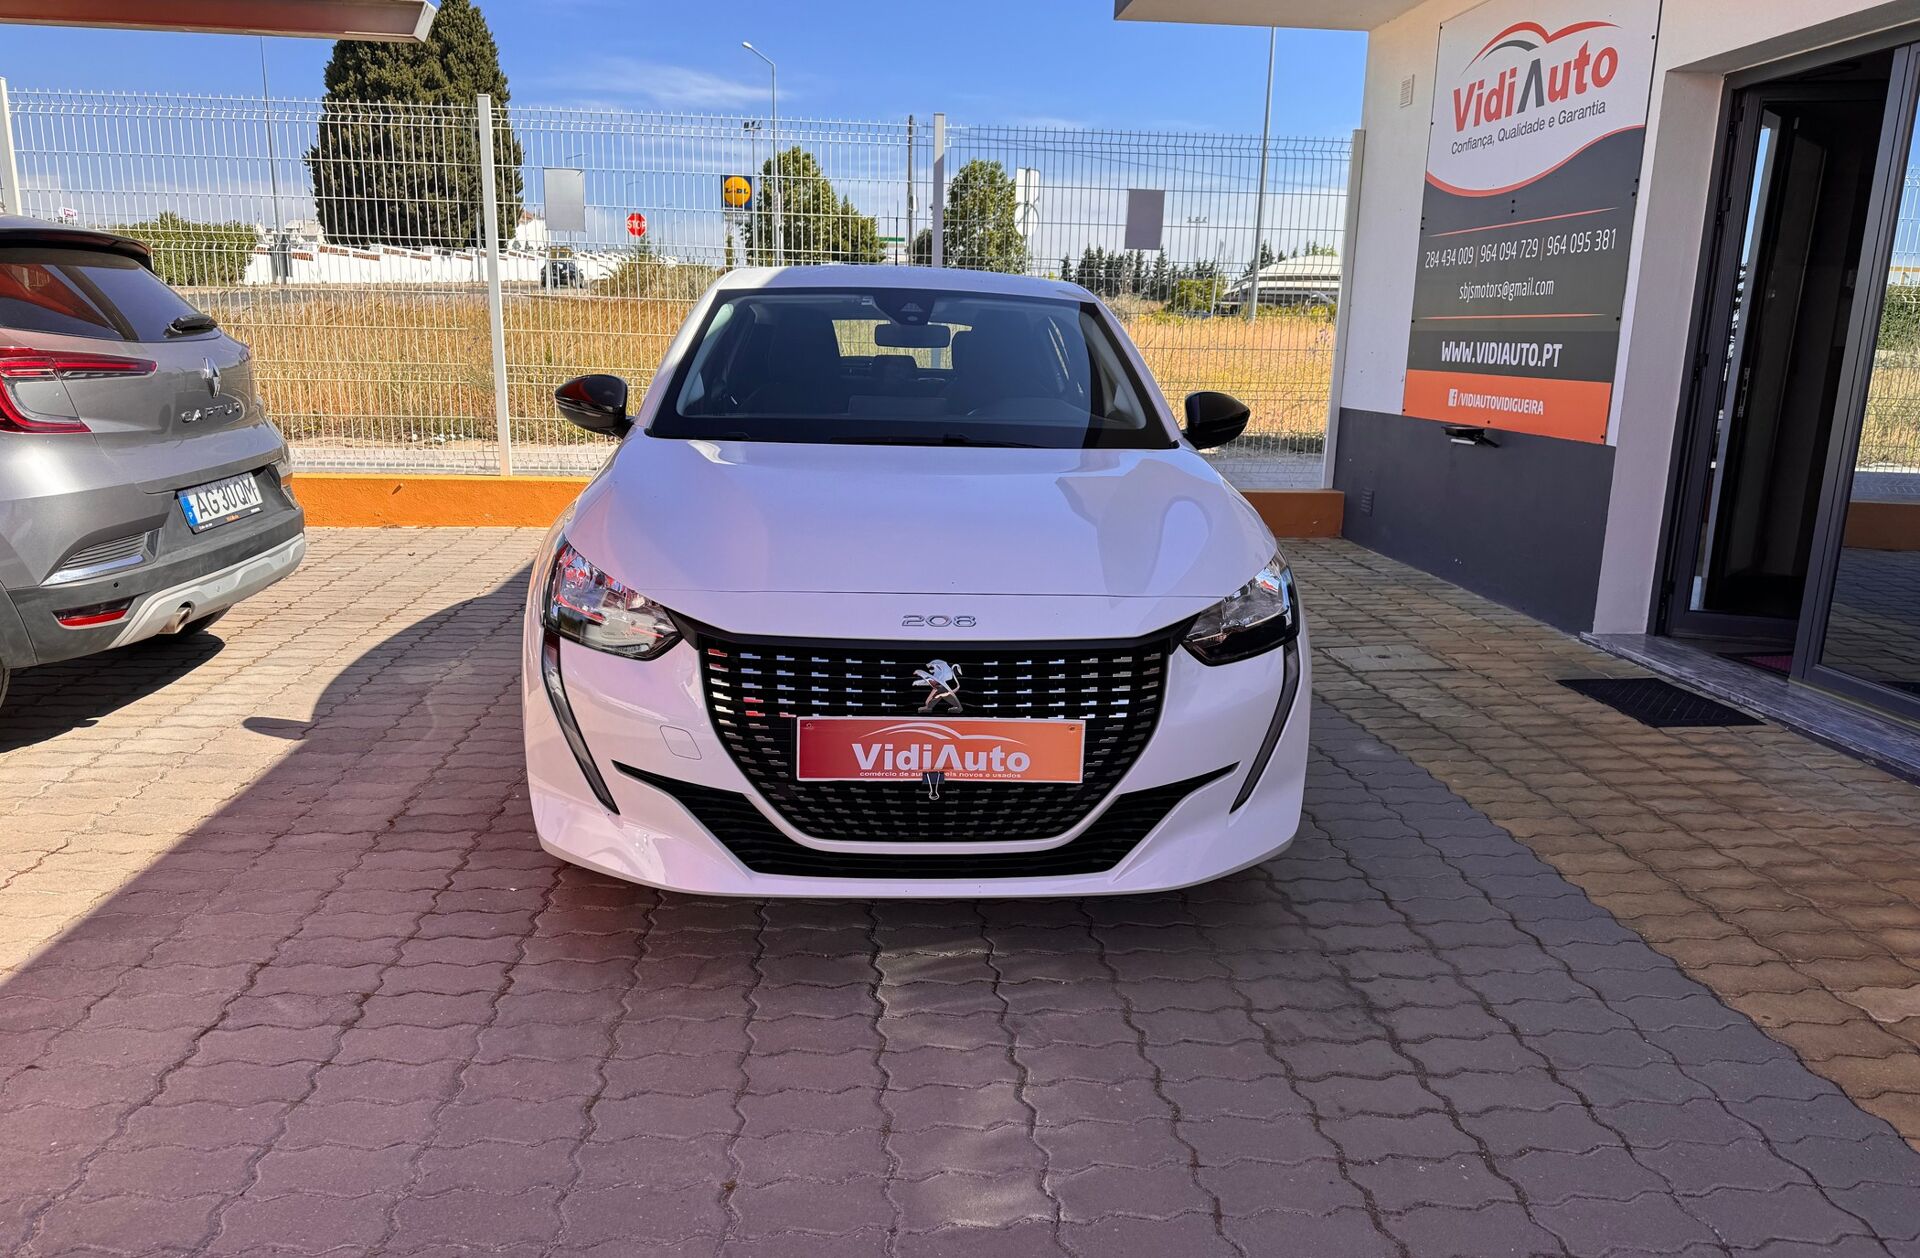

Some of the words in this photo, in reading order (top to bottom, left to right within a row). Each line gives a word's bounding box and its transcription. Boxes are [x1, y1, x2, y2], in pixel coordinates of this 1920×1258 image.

[1453, 40, 1619, 132] VidiAuto
[1451, 130, 1495, 155] Confiança,
[1497, 117, 1546, 142] Qualidade
[1548, 116, 1555, 128] e
[1558, 99, 1606, 125] Garantia
[627, 220, 647, 229] STOP
[1425, 250, 1440, 268] 284
[1441, 248, 1456, 266] 434
[1458, 246, 1474, 265] 009
[1480, 243, 1498, 263] 964
[1499, 241, 1518, 261] 094
[1519, 238, 1539, 259] 729
[1546, 234, 1567, 256] 964
[1569, 231, 1592, 254] 095
[1594, 228, 1617, 251] 381
[1459, 277, 1554, 302] sbjsmotors@gmail.com
[1441, 341, 1563, 368] WWW.VIDIAUTO.PT
[901, 614, 977, 628] 208
[852, 743, 1031, 772] VidiAuto
